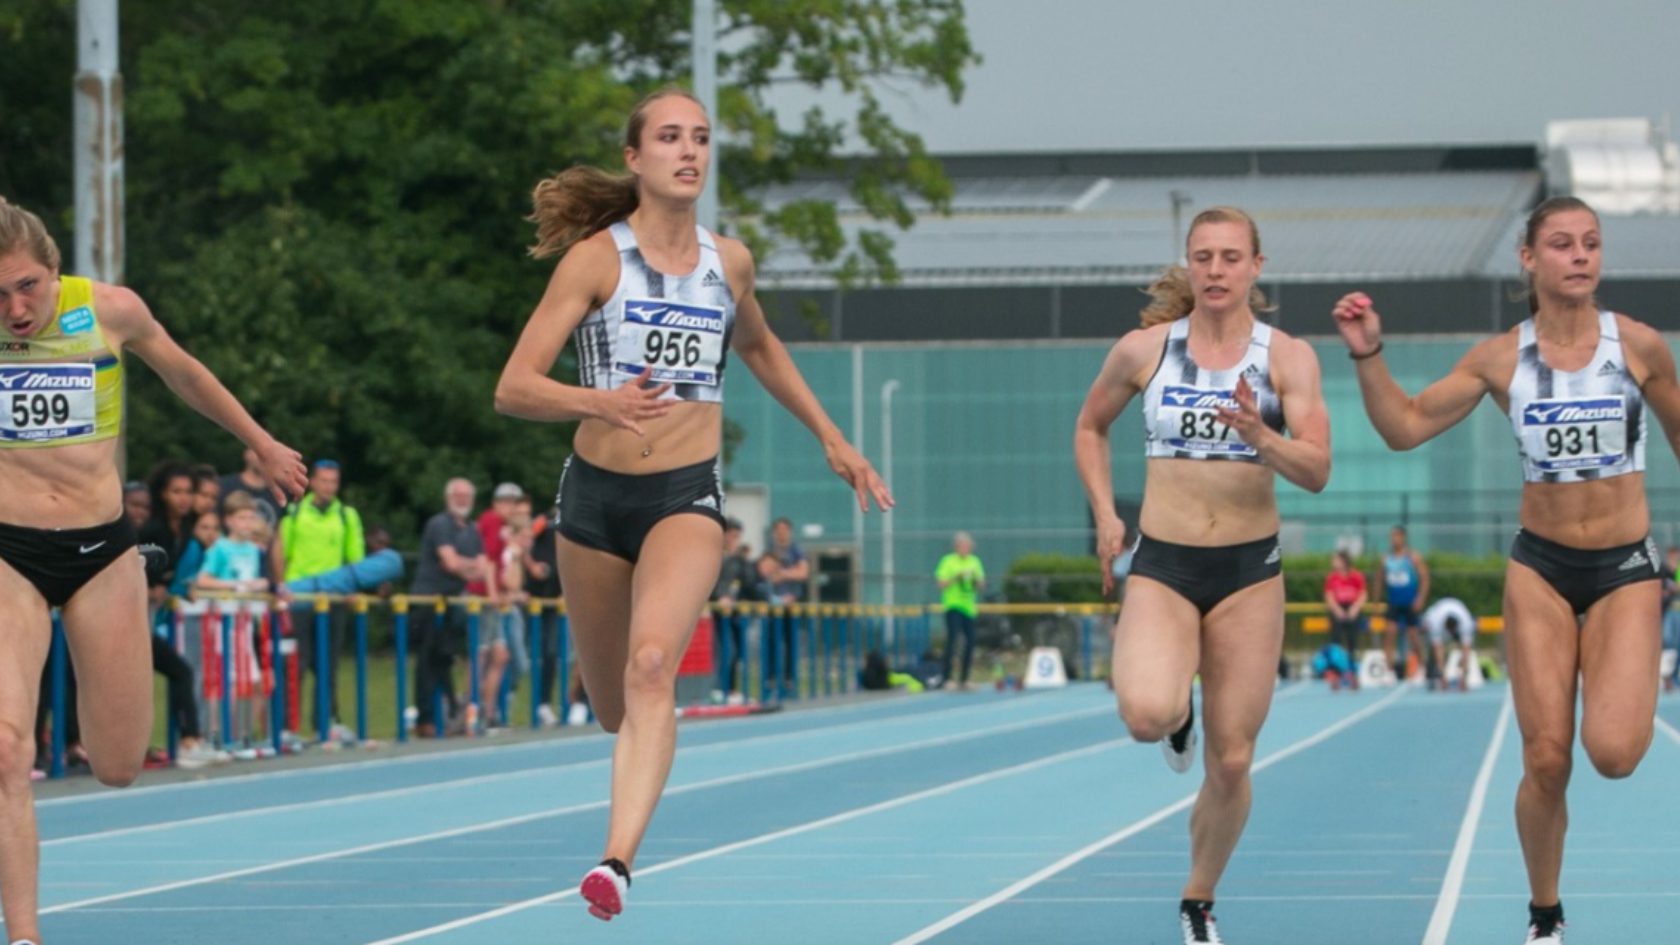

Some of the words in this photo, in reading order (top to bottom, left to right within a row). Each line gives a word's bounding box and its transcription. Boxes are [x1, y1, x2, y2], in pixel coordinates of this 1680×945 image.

[659, 310, 722, 330] MIZUNO
[643, 329, 702, 367] 956
[22, 373, 92, 388] MIZUNO
[12, 393, 70, 427] 599
[1193, 394, 1241, 409] MIZU
[1555, 406, 1622, 422] MIZUNO
[1546, 425, 1600, 457] 931
